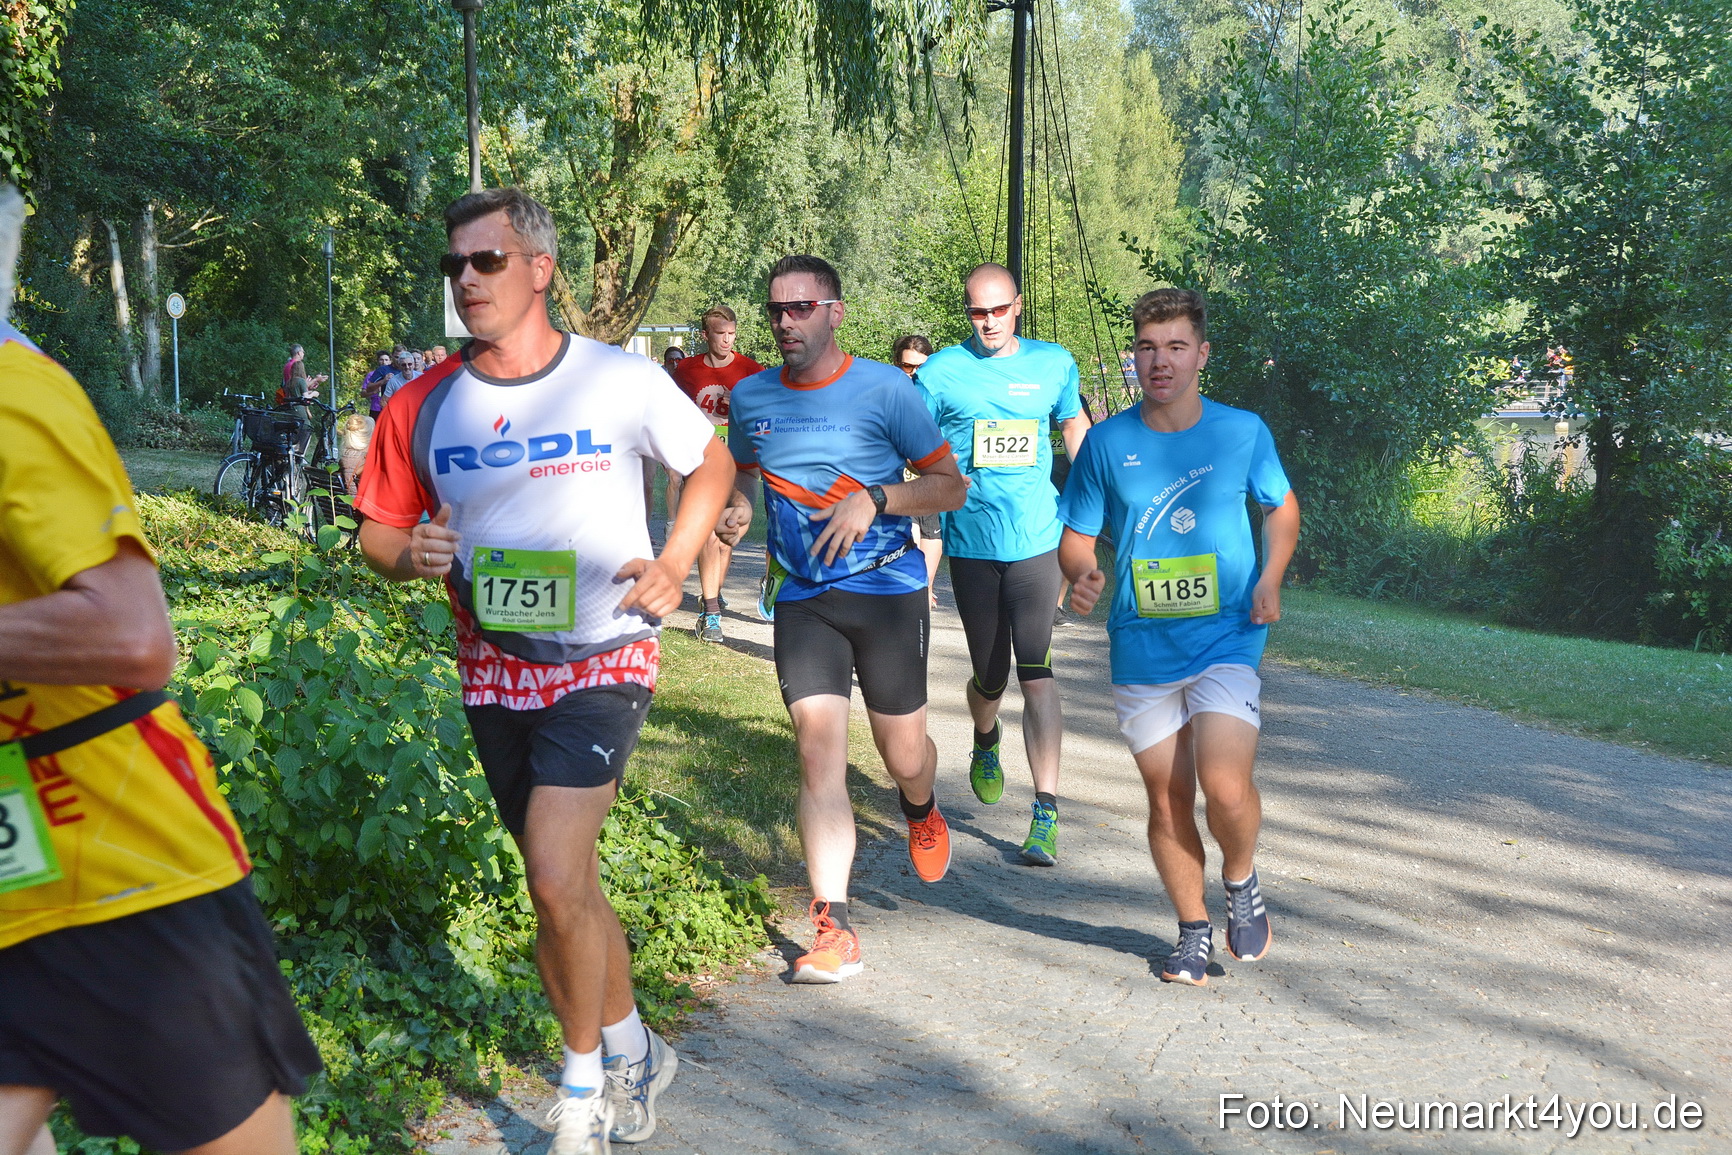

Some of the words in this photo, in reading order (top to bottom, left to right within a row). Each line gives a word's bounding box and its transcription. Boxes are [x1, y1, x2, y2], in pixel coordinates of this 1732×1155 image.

[774, 416, 828, 425] Raiffeisenbank
[774, 425, 810, 434] Neumarkt
[983, 437, 1029, 453] 1522
[529, 451, 612, 478] energie
[1134, 506, 1155, 534] Team
[1152, 476, 1189, 506] Schick
[1188, 464, 1214, 479] Bau
[483, 577, 556, 608] 1751
[1145, 577, 1207, 600] 1185
[485, 607, 533, 618] Wurzbacher
[535, 610, 556, 618] Jens
